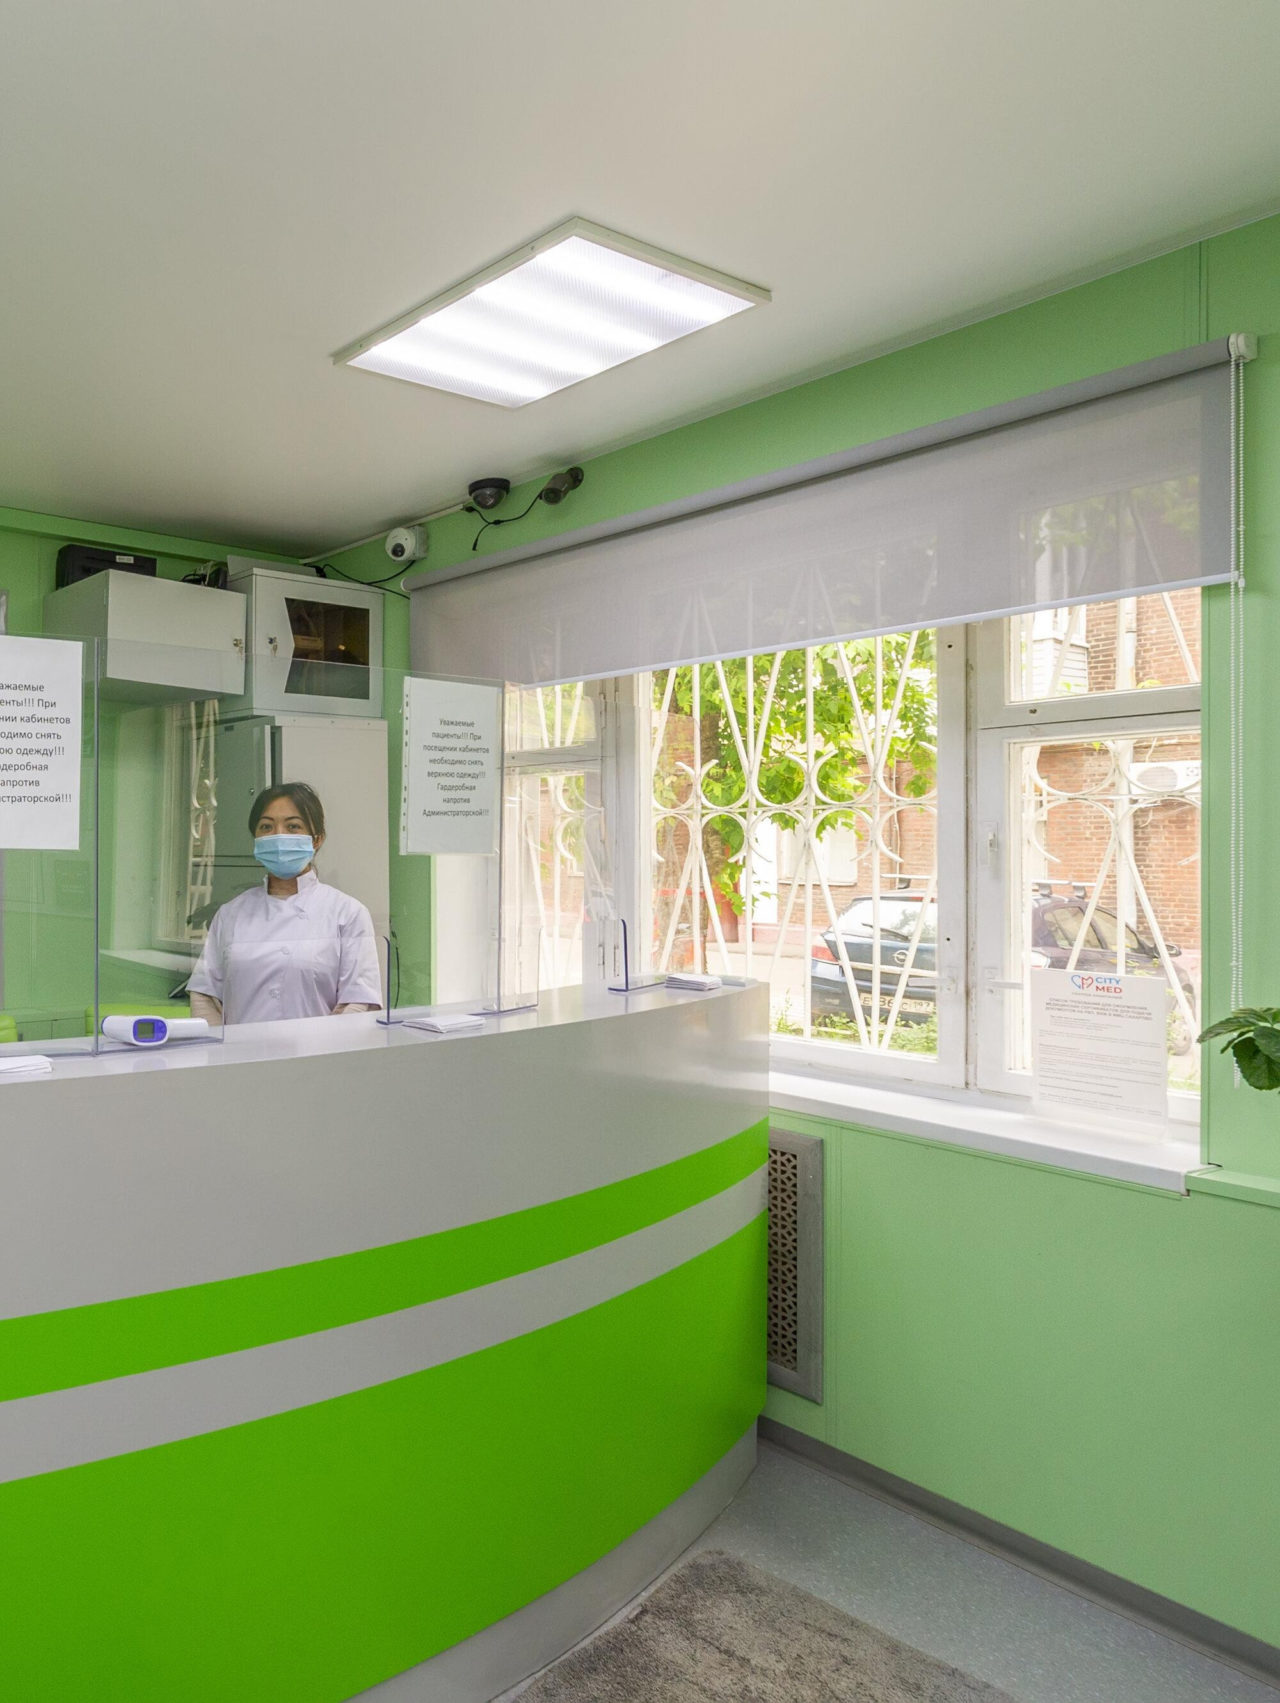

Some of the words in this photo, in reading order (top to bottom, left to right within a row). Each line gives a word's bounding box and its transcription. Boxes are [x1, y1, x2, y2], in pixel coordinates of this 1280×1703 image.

[37, 699, 57, 709] При
[20, 714, 71, 725] кабинетов
[439, 719, 475, 727] Уважаемые
[35, 731, 62, 740] снять
[469, 733, 482, 741] При
[16, 746, 65, 757] одежду!!!
[423, 744, 458, 752] посещении
[459, 745, 490, 753] кабинетов
[429, 757, 467, 767] необходимо
[467, 758, 484, 767] снять
[427, 770, 456, 779] верхнюю
[436, 783, 476, 792] Гардеробная
[442, 796, 471, 805] напротив
[1095, 977, 1121, 985] CITY
[1095, 985, 1123, 994] MED
